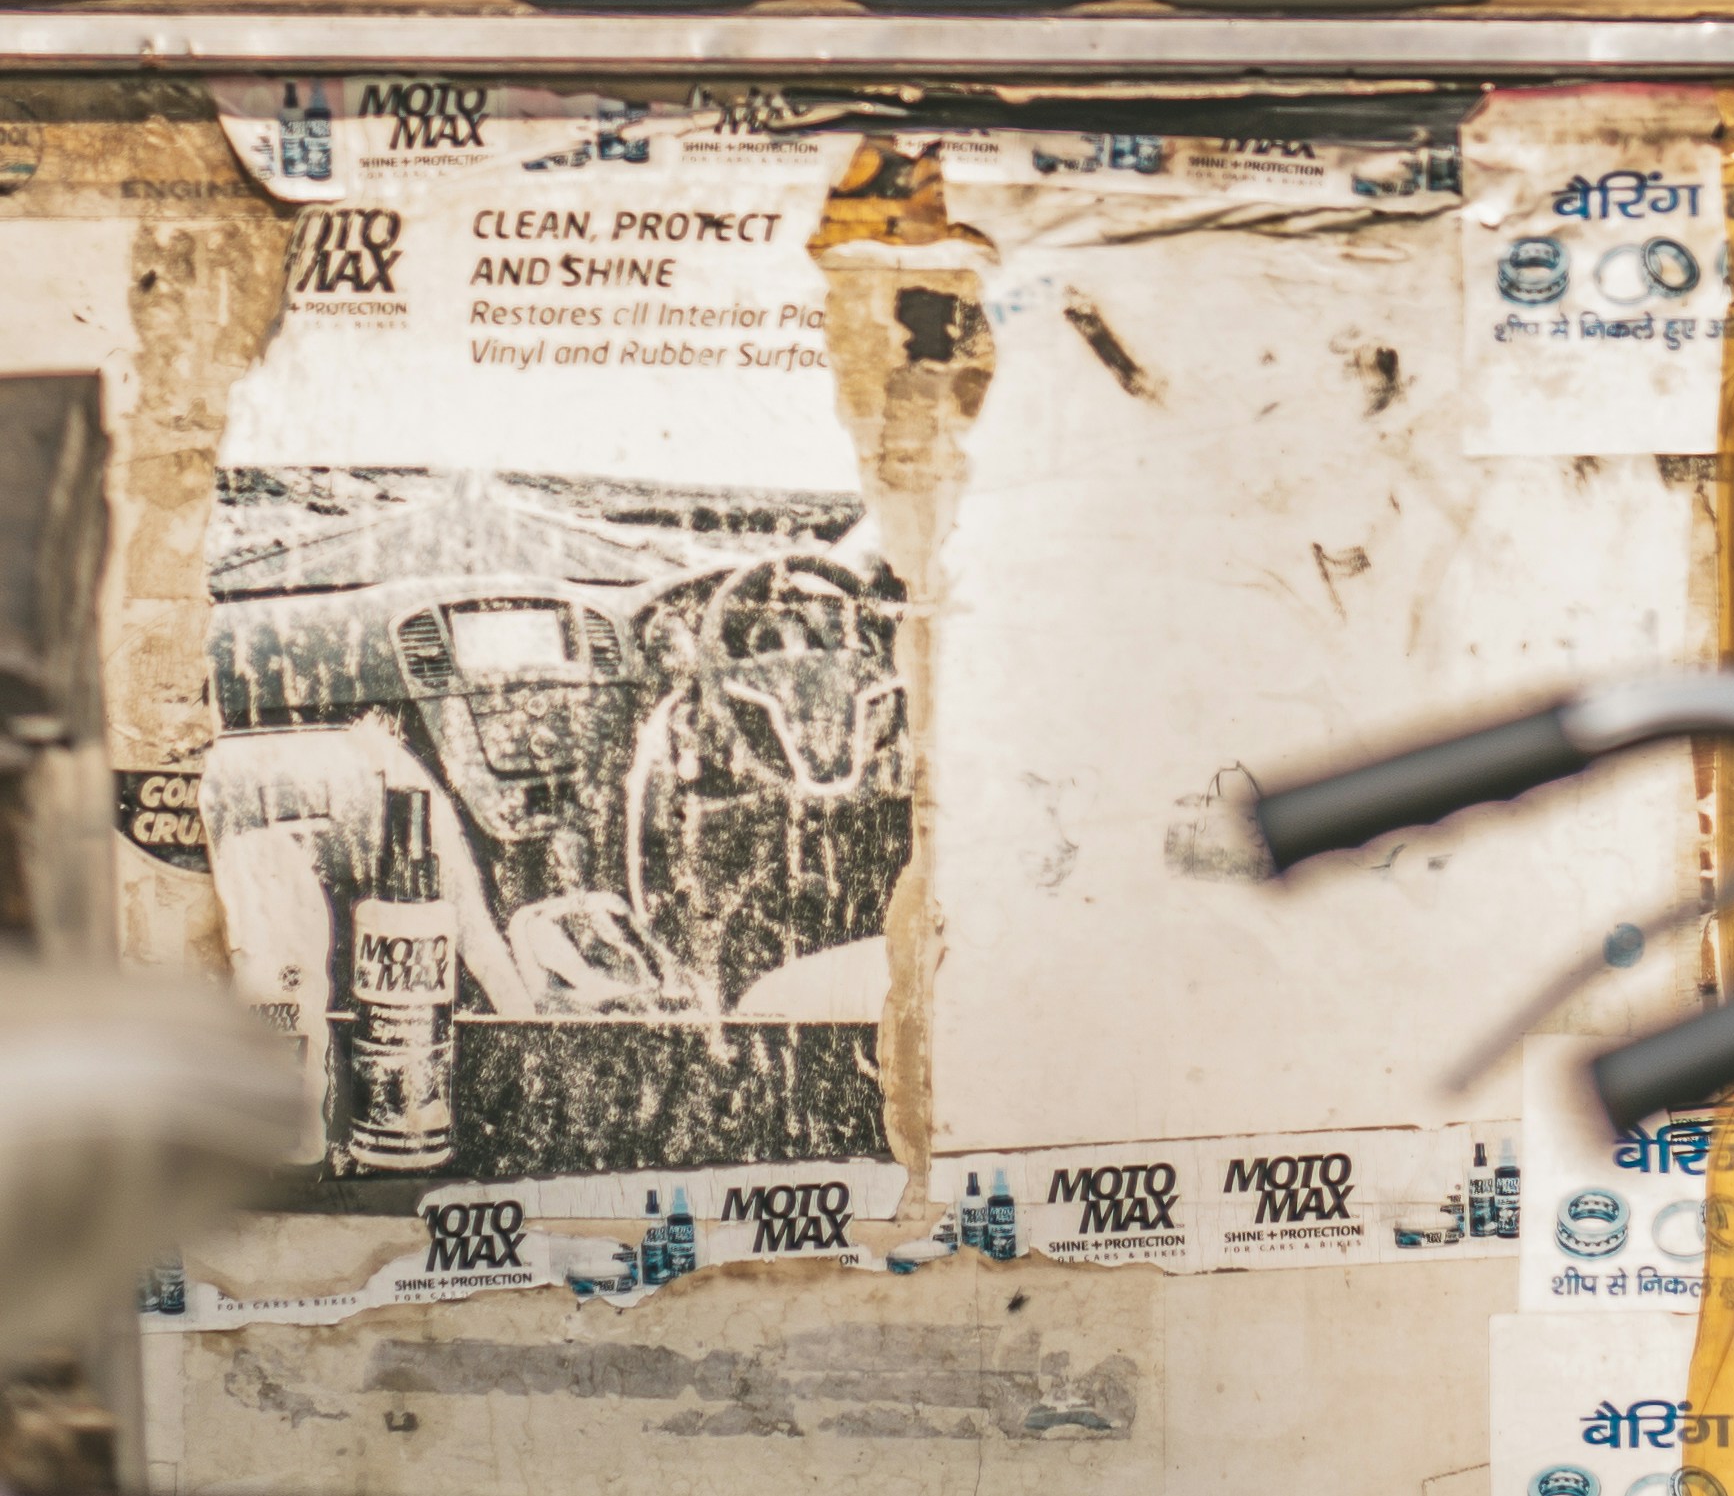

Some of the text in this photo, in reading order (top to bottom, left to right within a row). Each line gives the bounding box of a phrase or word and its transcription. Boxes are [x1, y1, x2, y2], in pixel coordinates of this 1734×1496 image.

[357, 83, 488, 119] MOTO
[389, 113, 490, 150] MAX
[359, 157, 398, 168] SHINE
[682, 141, 722, 153] SHINE
[738, 142, 818, 154] PROTECTION
[1189, 156, 1227, 168] SHINE
[1244, 161, 1324, 176] PROTECTION
[472, 210, 782, 244] CLEAN, PROTECT
[469, 256, 677, 287] AND SHINE
[305, 302, 408, 316] PROTECTION
[470, 300, 602, 327] Restores
[658, 304, 767, 330] Interior
[471, 340, 545, 370] Vinyl
[554, 340, 609, 365] and
[620, 341, 727, 367] Rubber
[360, 933, 448, 964] MOTO
[376, 961, 449, 992] MAX
[1048, 1163, 1177, 1204] MOTO
[1223, 1152, 1353, 1193] MOTO
[721, 1181, 850, 1222] MOTO
[1079, 1194, 1181, 1235] MAX
[1255, 1185, 1355, 1225] MAX
[753, 1212, 854, 1254] MAX
[1048, 1239, 1090, 1253] SHINE
[1105, 1235, 1185, 1250] PROTECTION
[1223, 1229, 1265, 1243] SHINE
[1280, 1224, 1361, 1239] PROTECTION
[425, 1232, 527, 1273] MAX
[1084, 1253, 1119, 1263] CARS
[1144, 1249, 1186, 1259] BIKES
[1224, 1246, 1251, 1254] FOR
[1260, 1244, 1295, 1253] CARS
[394, 1279, 435, 1291] SHINE
[451, 1273, 533, 1288] PROTECTION
[1606, 1268, 1629, 1296] से
[253, 1300, 289, 1309] CARS
[314, 1297, 358, 1306] BIKES
[1580, 1400, 1734, 1450] बैरिंग
